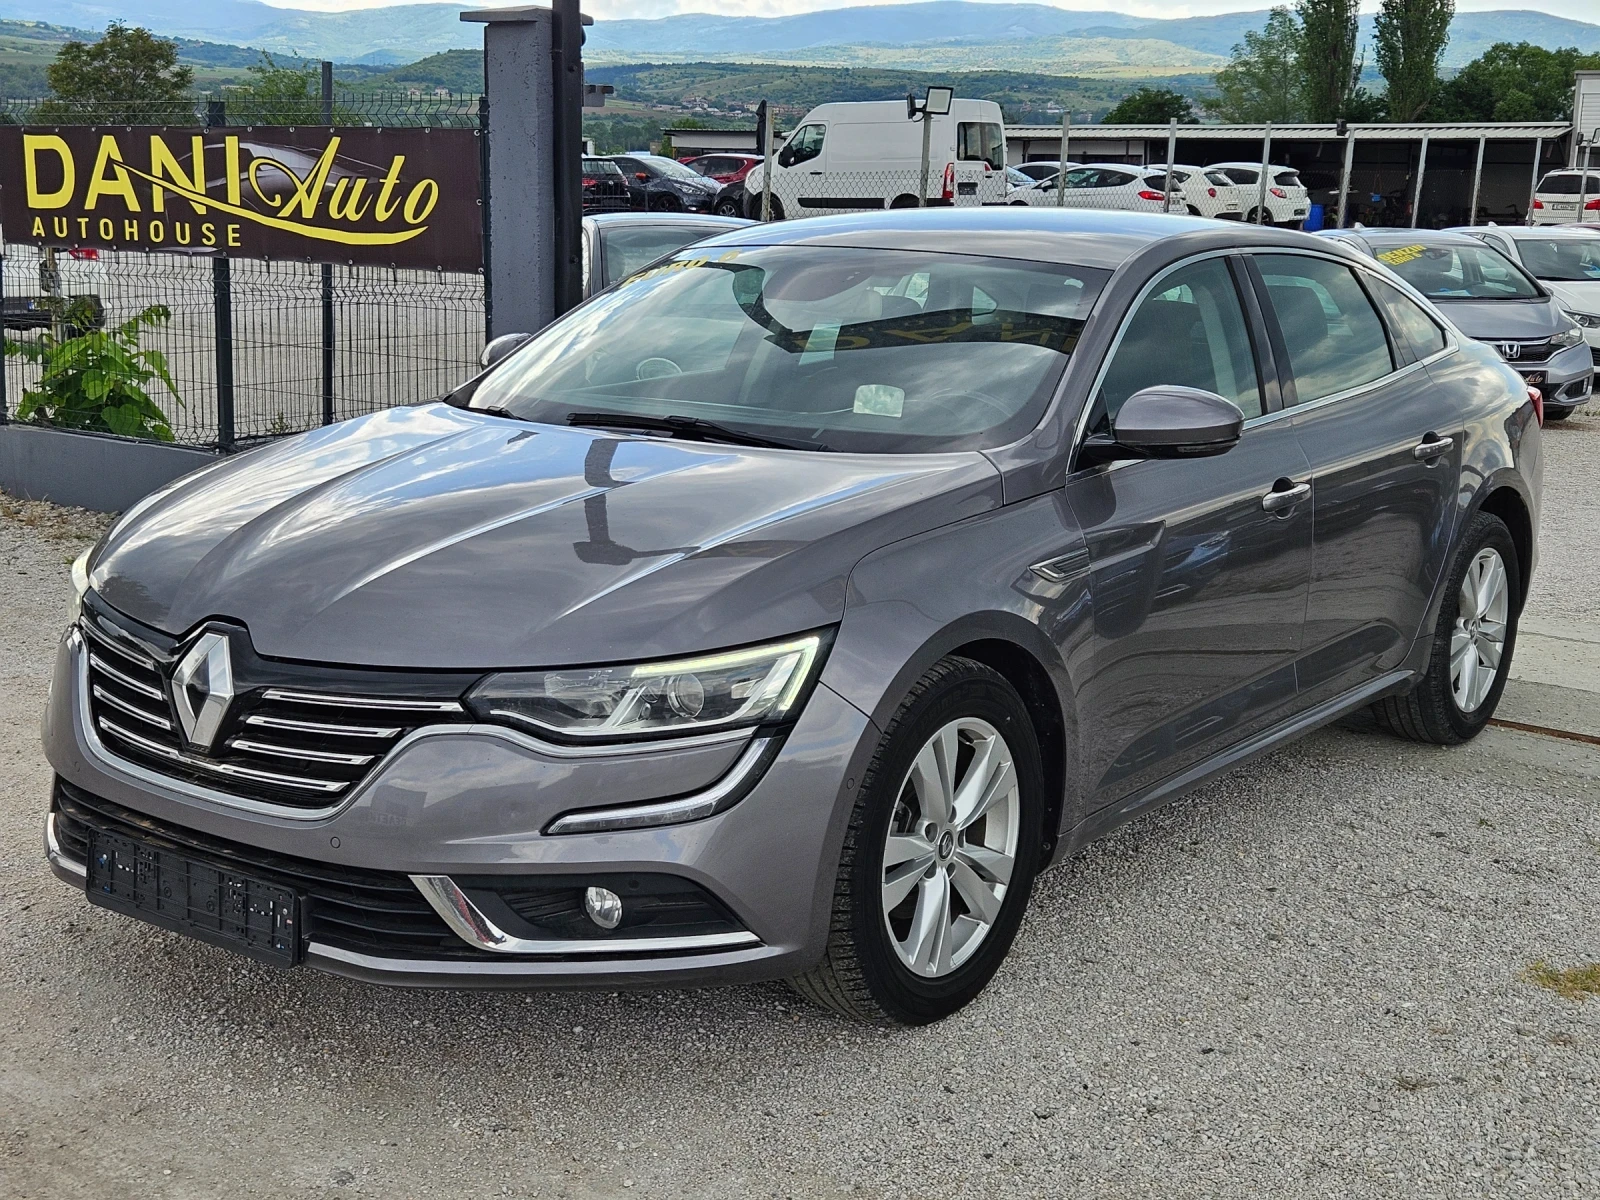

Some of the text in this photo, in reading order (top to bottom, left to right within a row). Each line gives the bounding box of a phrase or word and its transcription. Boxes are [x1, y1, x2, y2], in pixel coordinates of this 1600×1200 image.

[23, 134, 439, 225] DANI Auto
[32, 216, 242, 247] AUTOHOUSE
[1377, 244, 1427, 261] BENZIN
[619, 255, 711, 288] EURO
